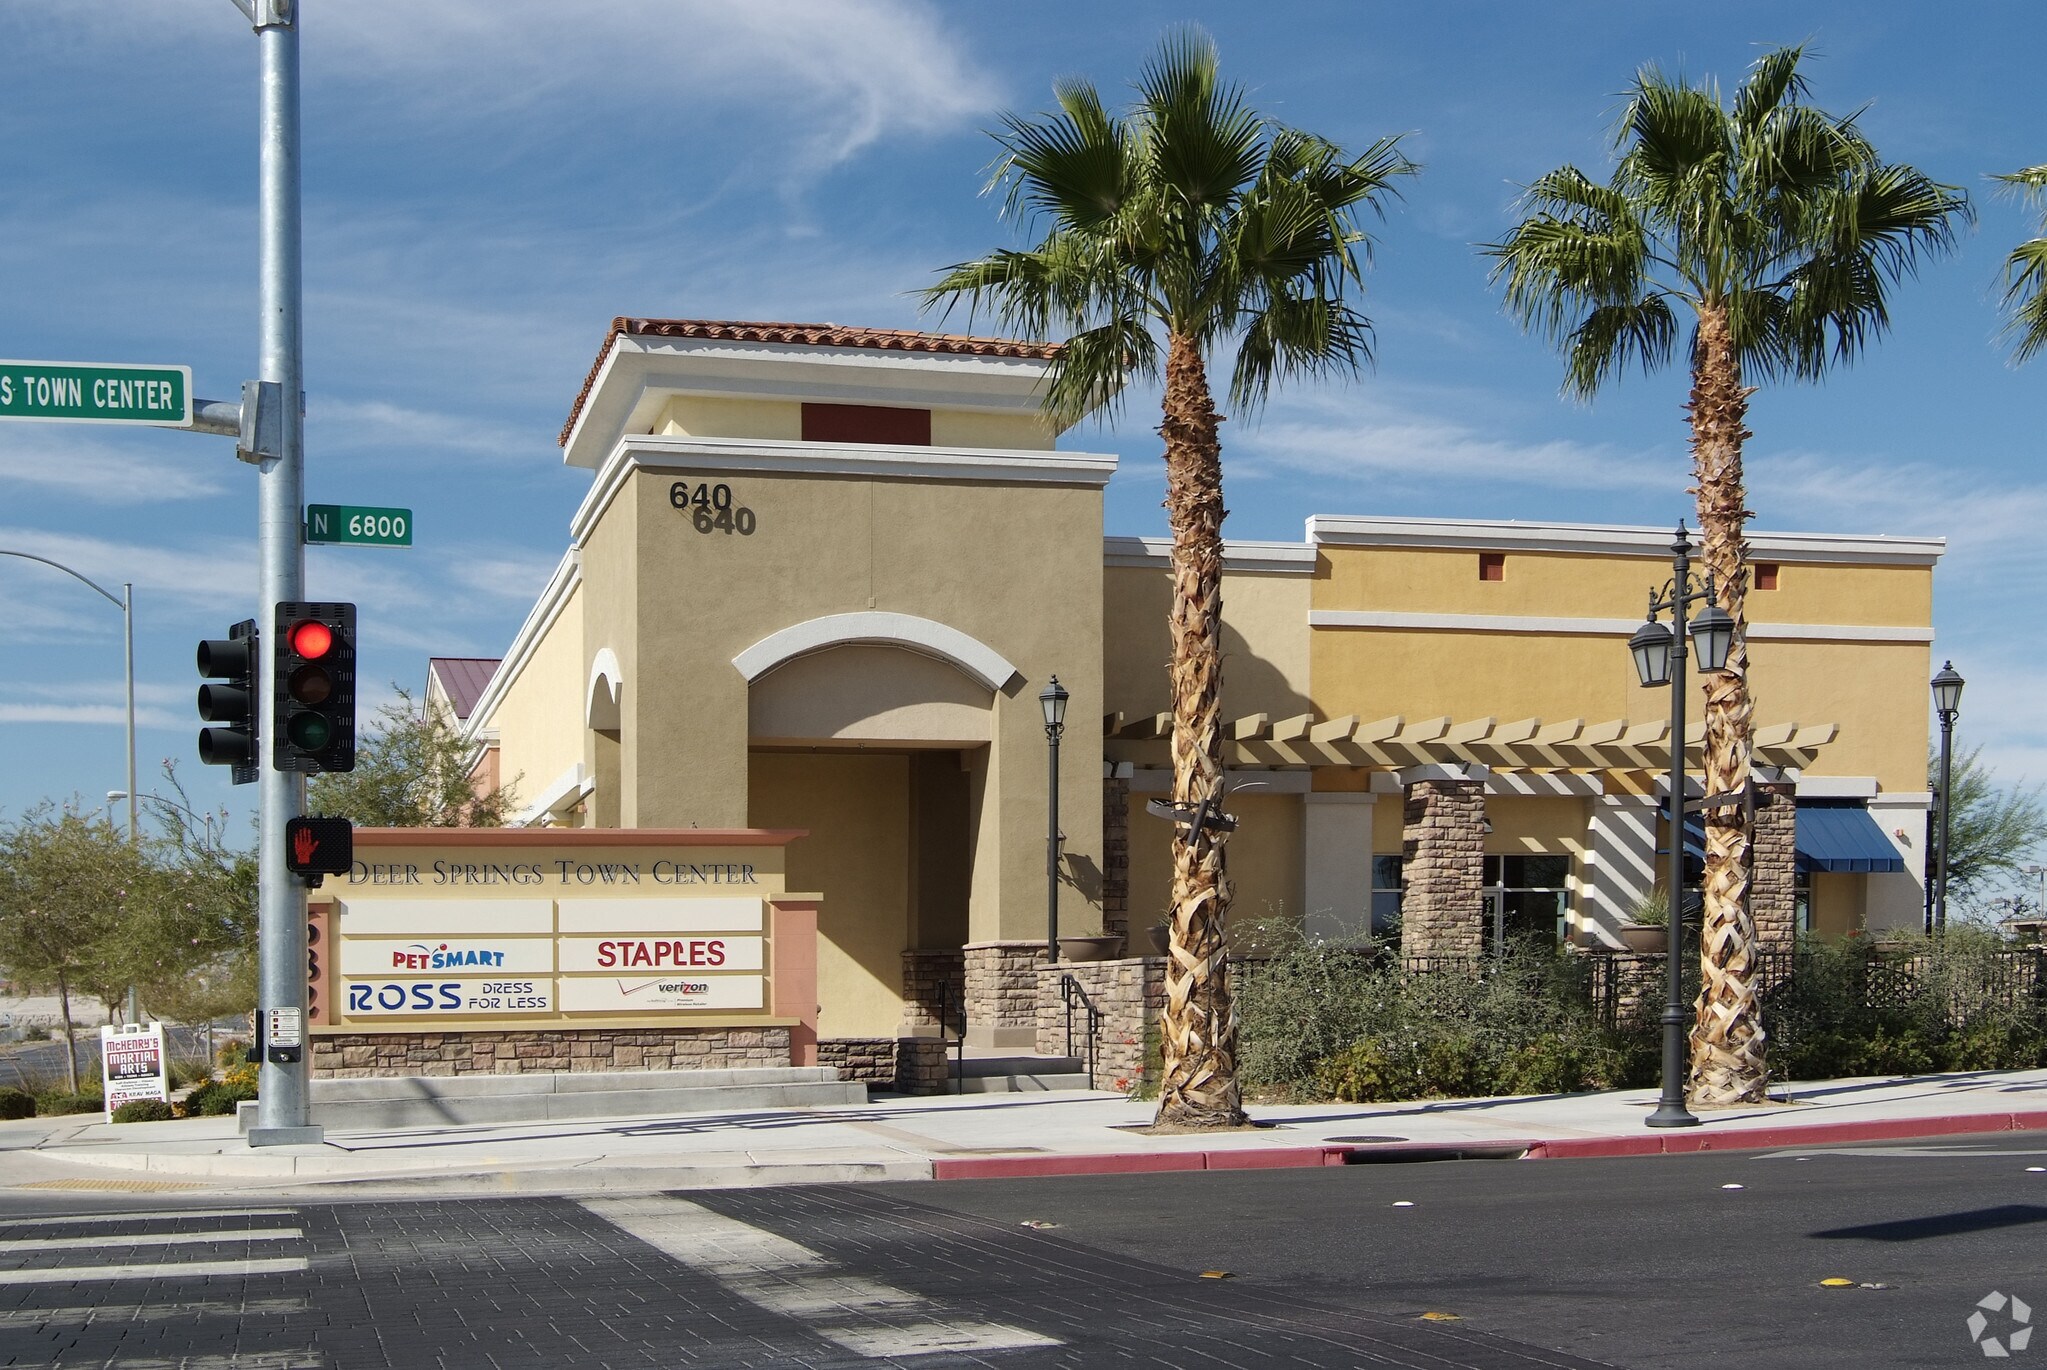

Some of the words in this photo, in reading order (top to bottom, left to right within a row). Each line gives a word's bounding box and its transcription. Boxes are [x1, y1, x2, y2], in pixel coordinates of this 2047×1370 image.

[24, 376, 82, 407] TOWN
[94, 379, 173, 410] CENTER
[670, 482, 732, 510] 640
[315, 513, 328, 534] N
[349, 515, 406, 538] 6800
[348, 861, 422, 885] DEER
[433, 860, 544, 885] SPRINGS
[555, 860, 640, 885] TOWN
[653, 860, 758, 885] CENTER
[597, 941, 725, 967] STAPLES
[350, 983, 461, 1011] ROSS
[482, 982, 533, 994] DRESS
[658, 981, 709, 995] verizon
[469, 997, 500, 1009] FOR
[507, 997, 547, 1009] LESS
[109, 1051, 158, 1065] MARTIAL
[120, 1062, 148, 1075] ARTS
